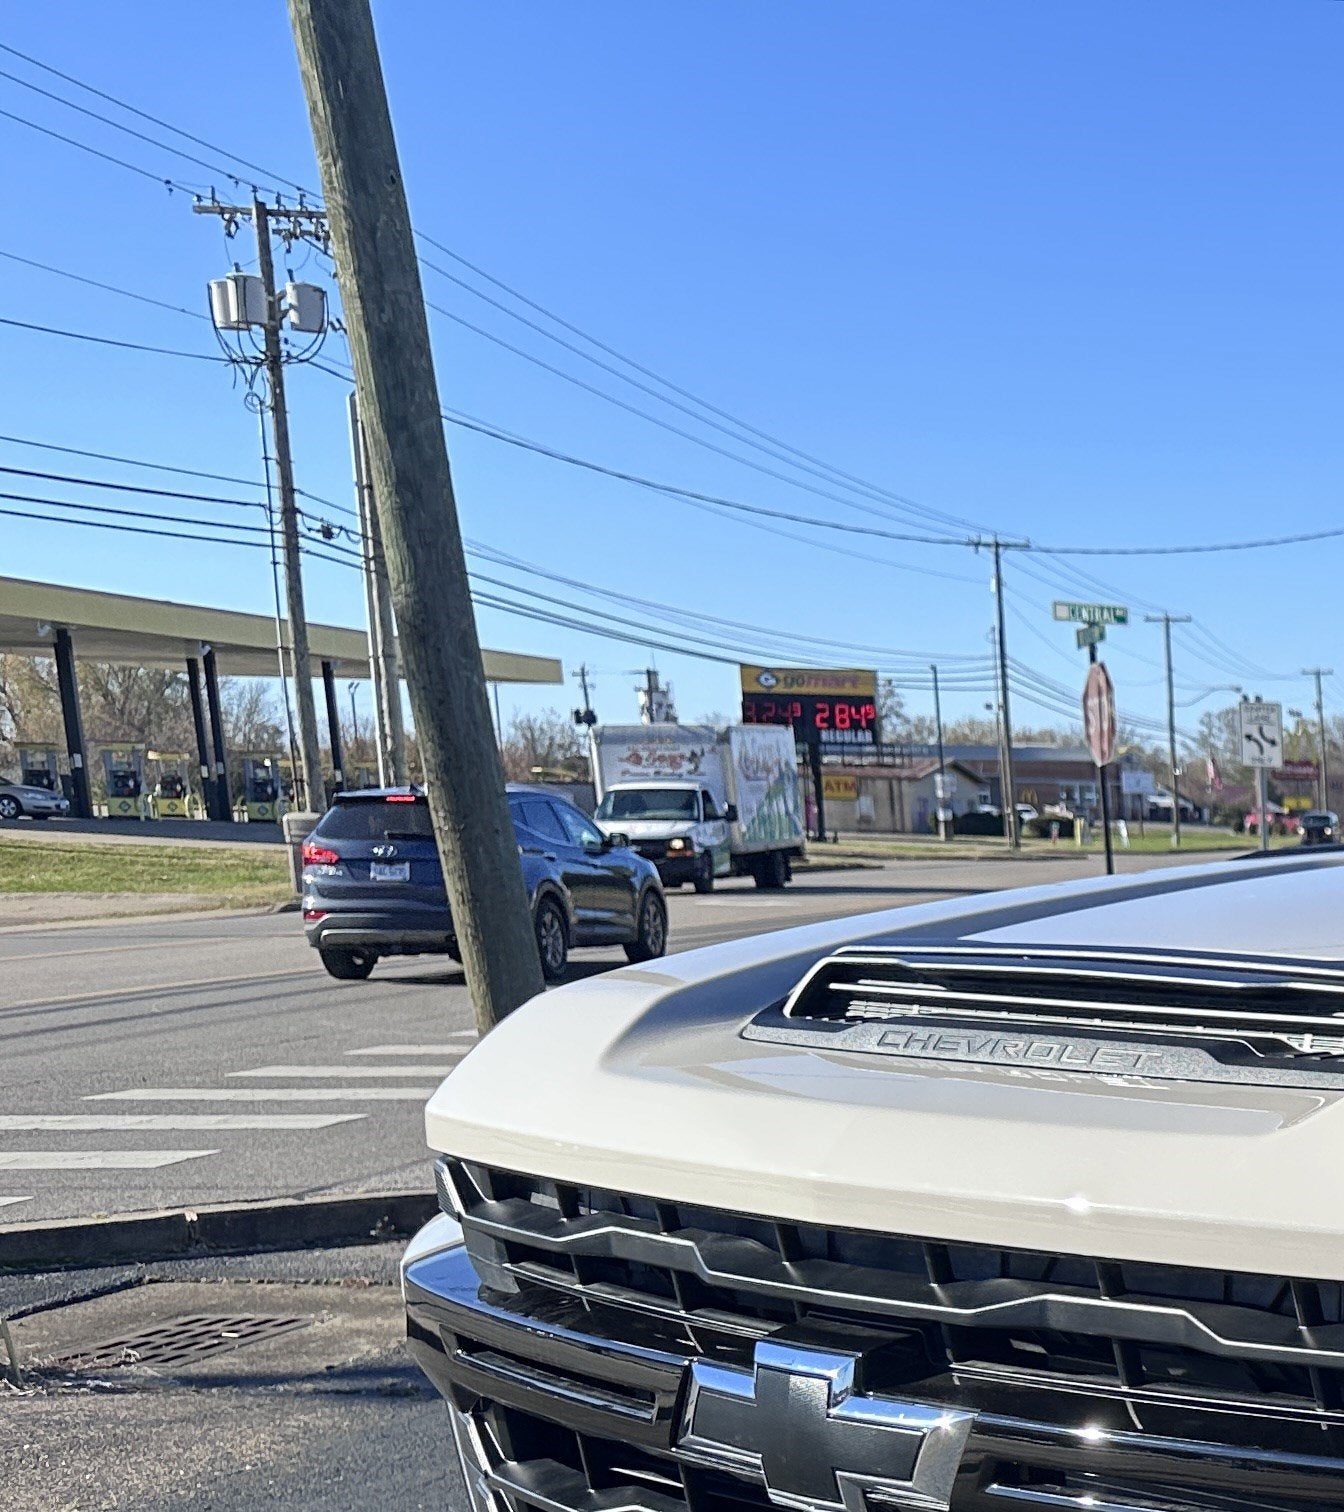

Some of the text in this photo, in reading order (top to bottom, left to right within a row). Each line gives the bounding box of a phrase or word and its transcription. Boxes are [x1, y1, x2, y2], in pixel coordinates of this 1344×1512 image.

[1070, 604, 1114, 623] CENTRAL
[824, 781, 857, 792] ATM
[876, 1030, 1163, 1068] CHEVROLET
